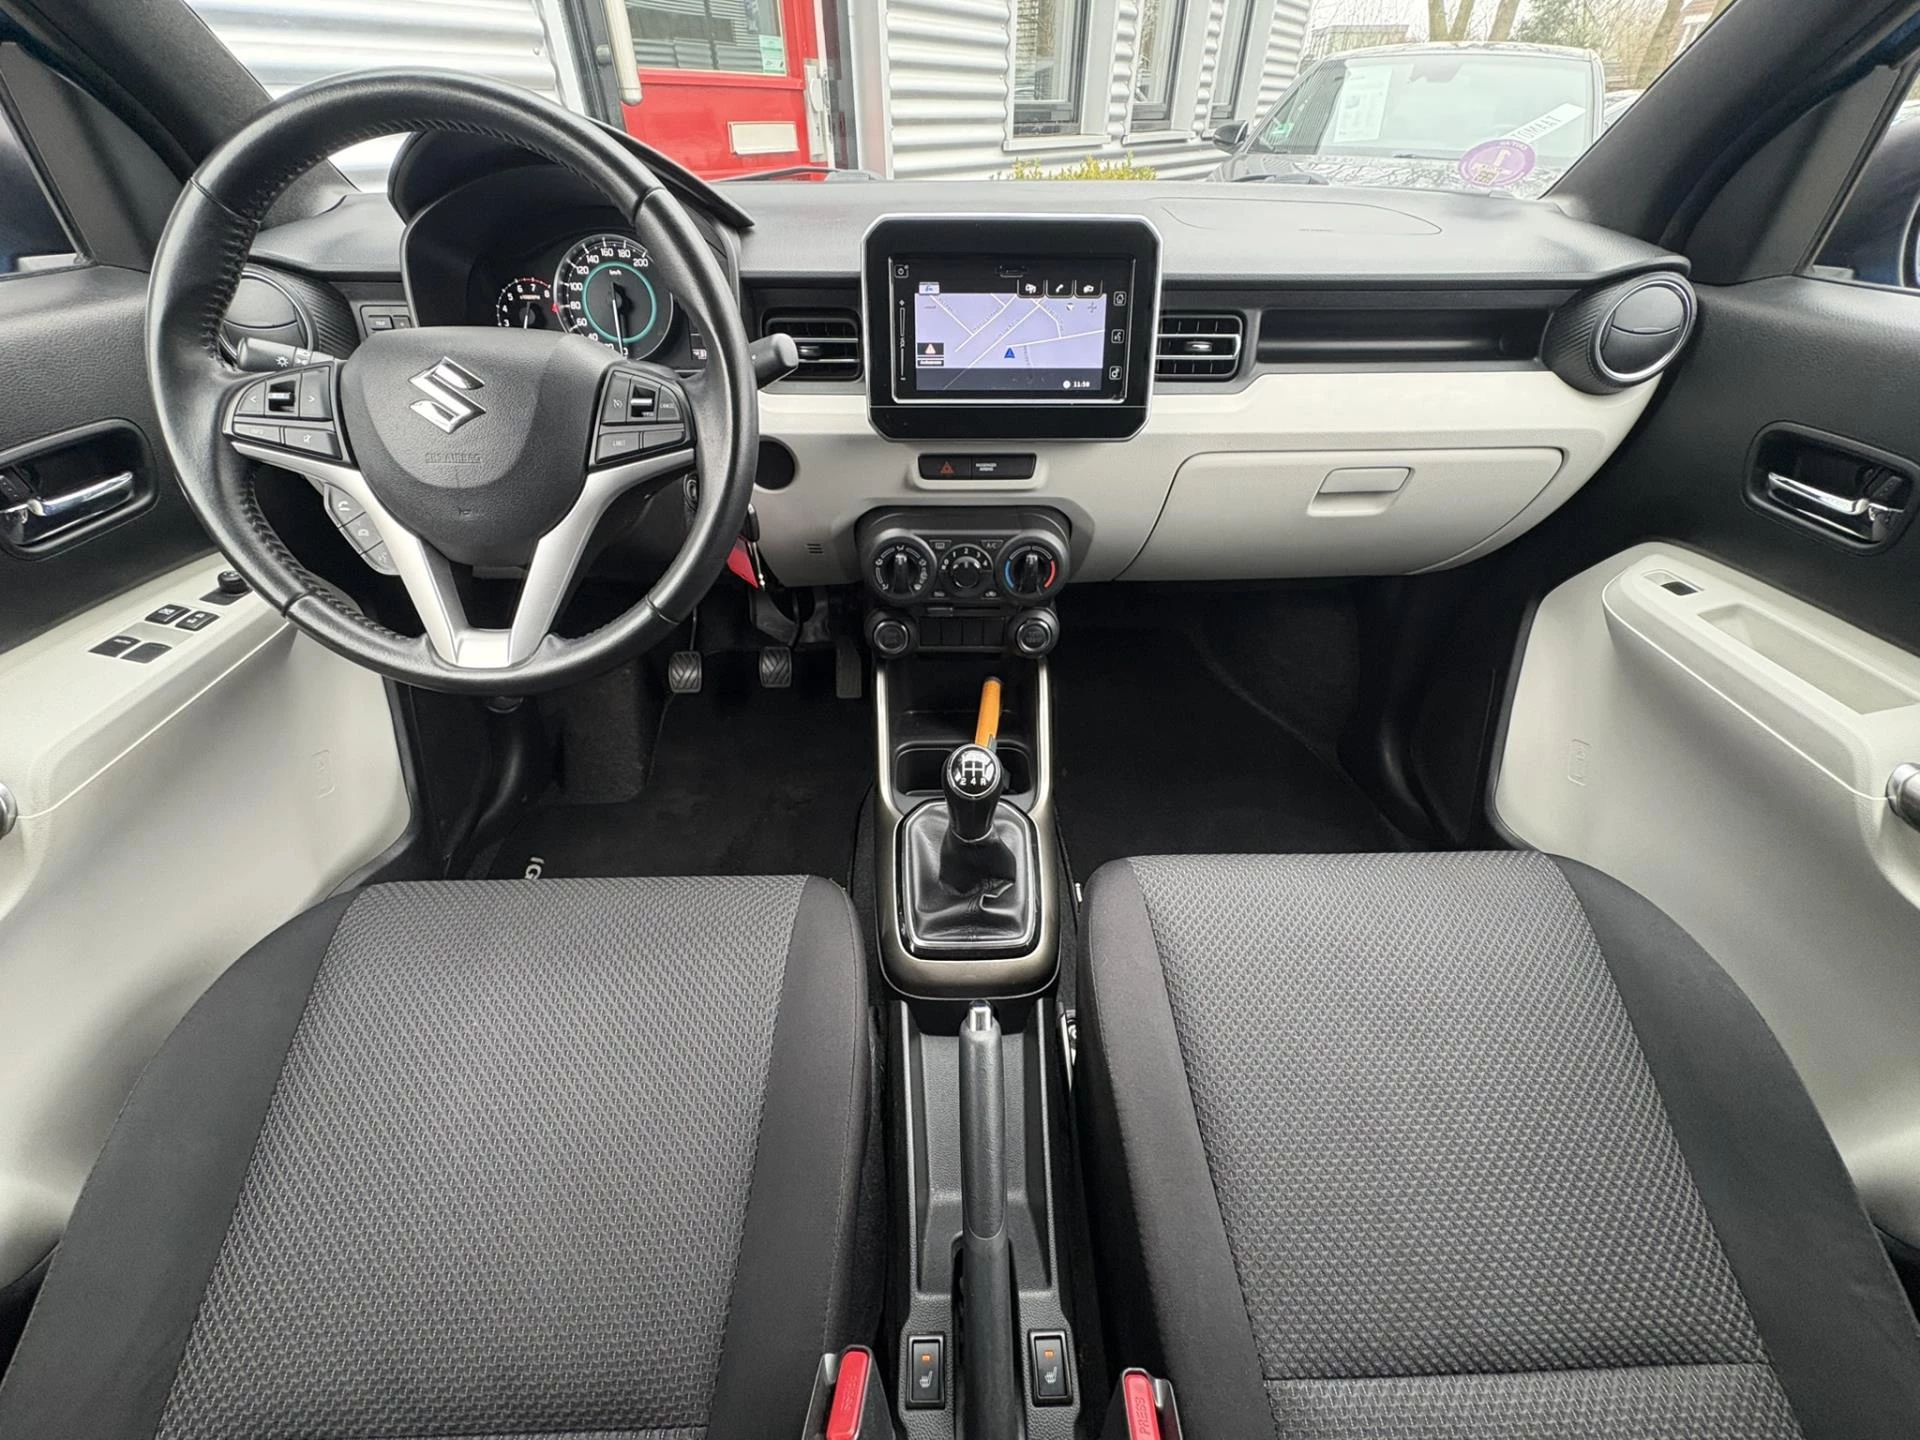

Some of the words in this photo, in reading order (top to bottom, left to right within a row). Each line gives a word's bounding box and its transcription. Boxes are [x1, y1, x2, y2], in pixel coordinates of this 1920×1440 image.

[601, 248, 614, 257] 160
[618, 249, 631, 258] 180
[586, 255, 600, 264] 140
[633, 258, 648, 267] 200
[576, 266, 589, 275] 120
[516, 284, 523, 293] 6
[530, 283, 536, 292] 7
[569, 282, 583, 291] 100
[507, 292, 514, 301] 5
[544, 289, 550, 298] 8
[502, 304, 508, 313] 4
[570, 301, 581, 310] 80
[503, 319, 510, 327] 3
[576, 317, 587, 327] 60
[960, 777, 967, 786] 2
[970, 777, 977, 786] 4
[980, 777, 987, 786] R
[1135, 1396, 1151, 1436] PRESS
